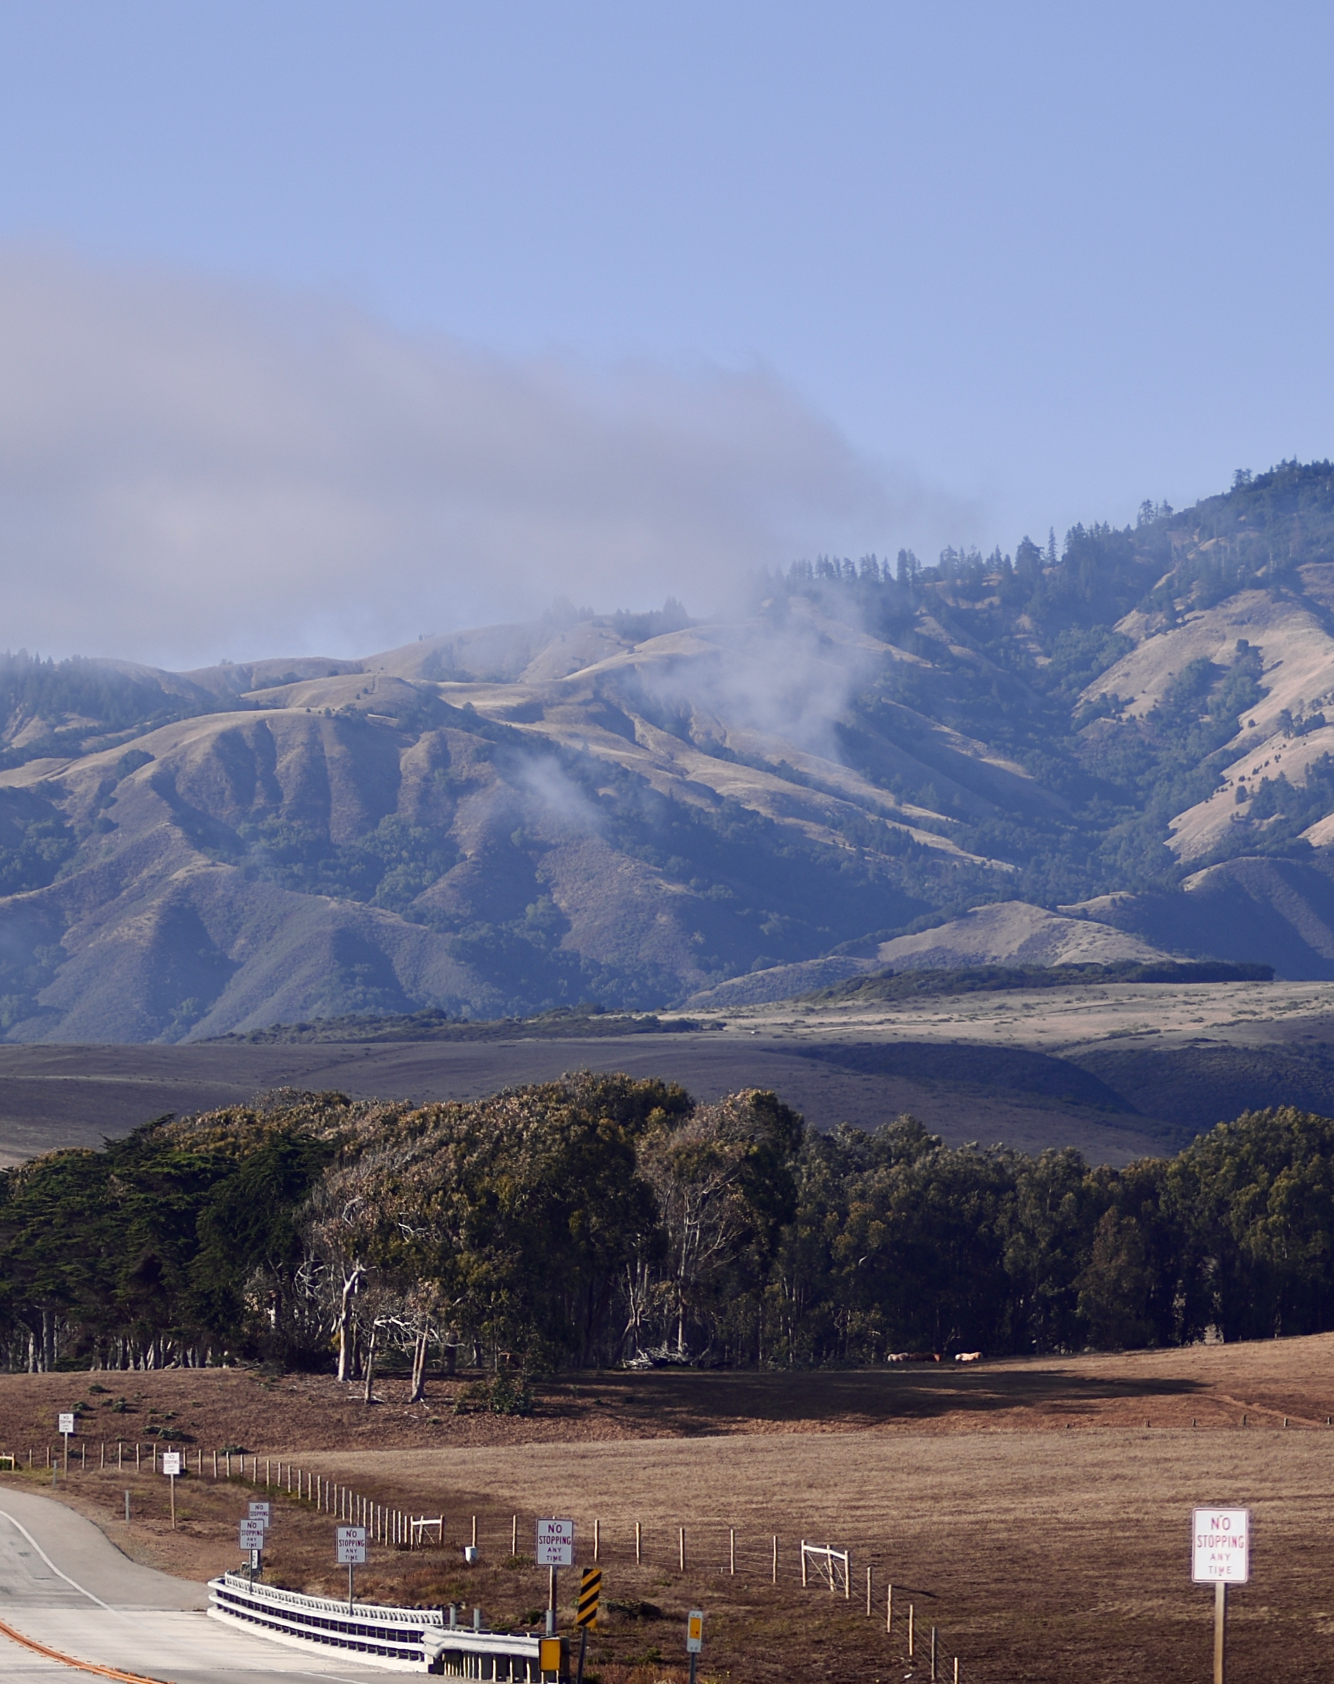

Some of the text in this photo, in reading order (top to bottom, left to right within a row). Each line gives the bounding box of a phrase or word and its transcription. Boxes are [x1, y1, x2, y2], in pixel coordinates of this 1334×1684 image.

[1210, 1517, 1231, 1530] NO
[548, 1524, 562, 1533] NO
[346, 1530, 358, 1538] NO
[339, 1539, 364, 1547] STOPPING
[539, 1535, 571, 1545] STOPPING
[1196, 1535, 1244, 1548] STOPPING
[1210, 1553, 1231, 1561] ANY
[1208, 1566, 1232, 1574] TIME
